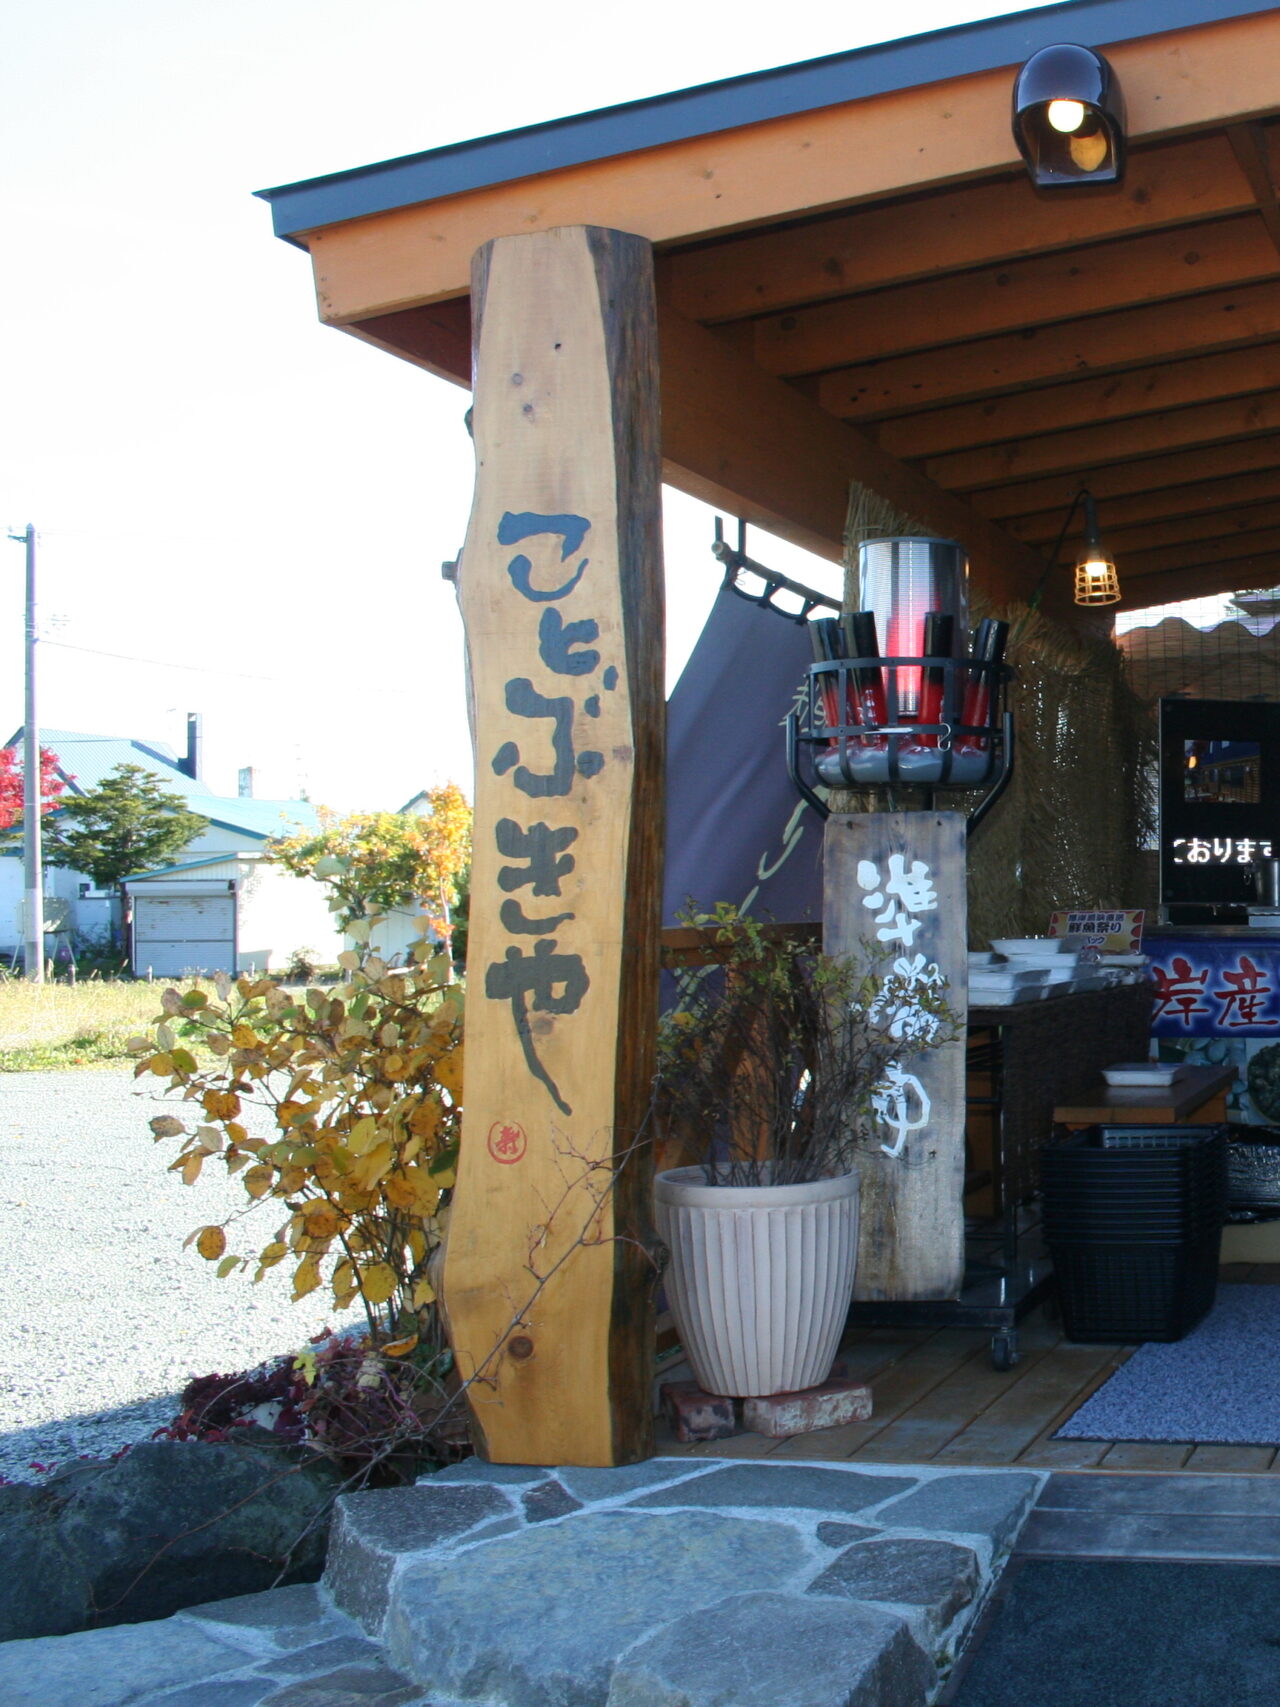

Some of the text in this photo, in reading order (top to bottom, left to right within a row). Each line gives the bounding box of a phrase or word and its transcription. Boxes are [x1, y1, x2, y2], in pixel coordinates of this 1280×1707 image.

[486, 511, 619, 1116] ことぶきや
